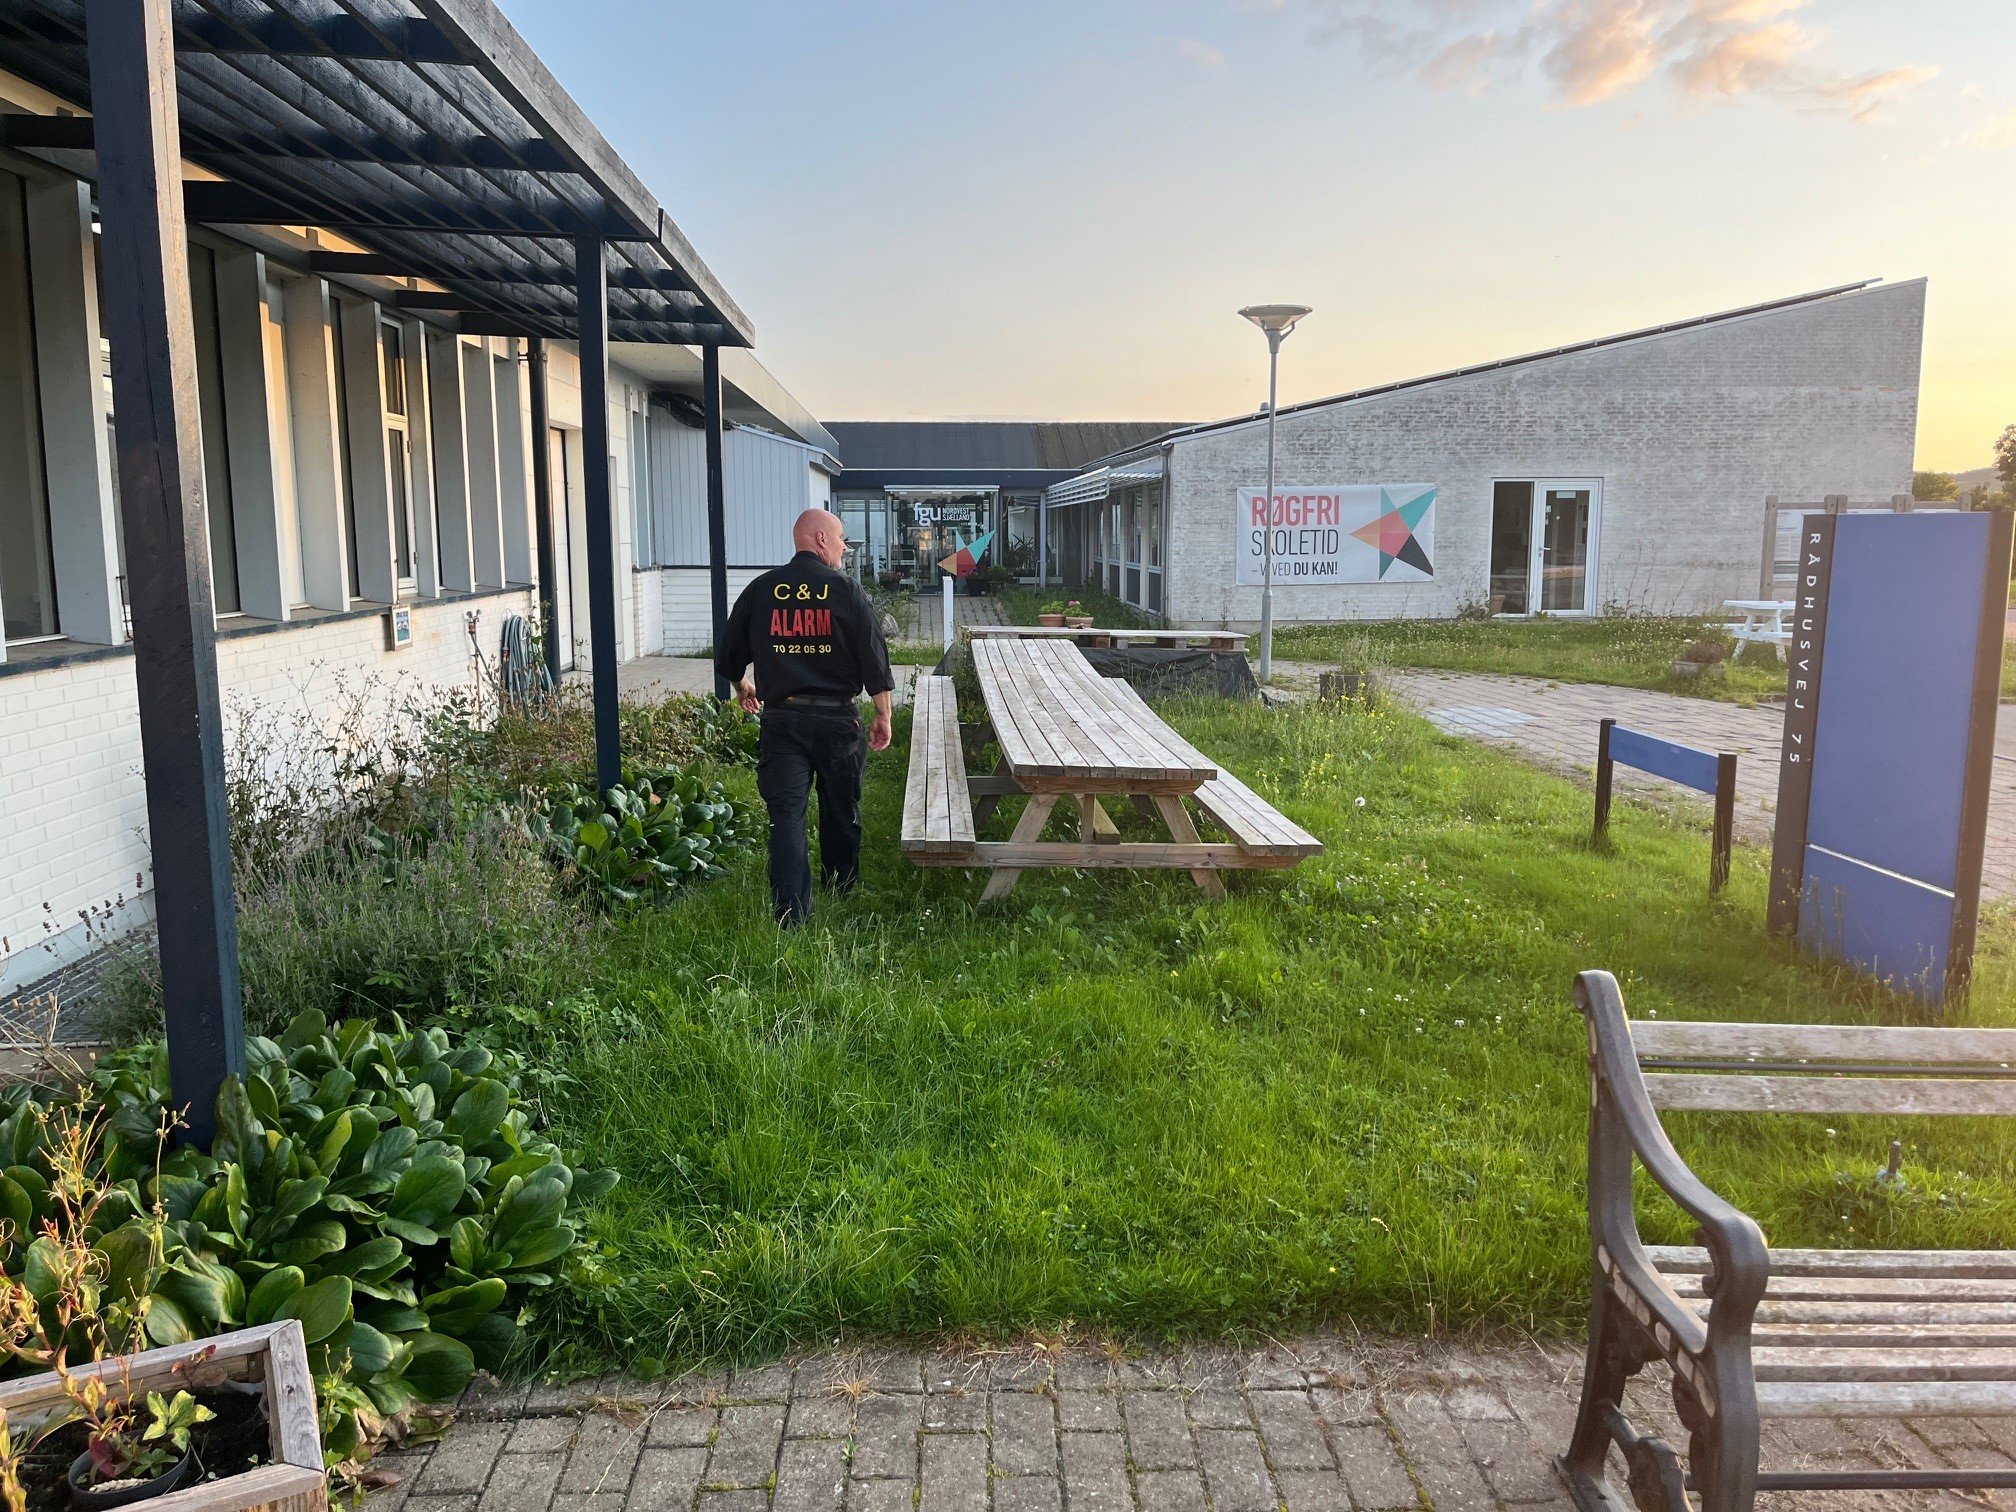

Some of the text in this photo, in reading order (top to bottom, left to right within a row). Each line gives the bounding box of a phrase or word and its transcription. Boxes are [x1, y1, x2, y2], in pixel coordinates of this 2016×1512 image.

[914, 502, 941, 526] fgu
[1251, 495, 1340, 526] RØGFRI
[1271, 562, 1291, 576] VED
[1294, 562, 1309, 576] DU
[1312, 561, 1338, 575] KAN!
[773, 583, 829, 600] C & J
[770, 608, 832, 636] ALARM
[773, 644, 832, 653] 70 22 05 30
[1789, 533, 1821, 763] RÅDHUSVEJ 75
